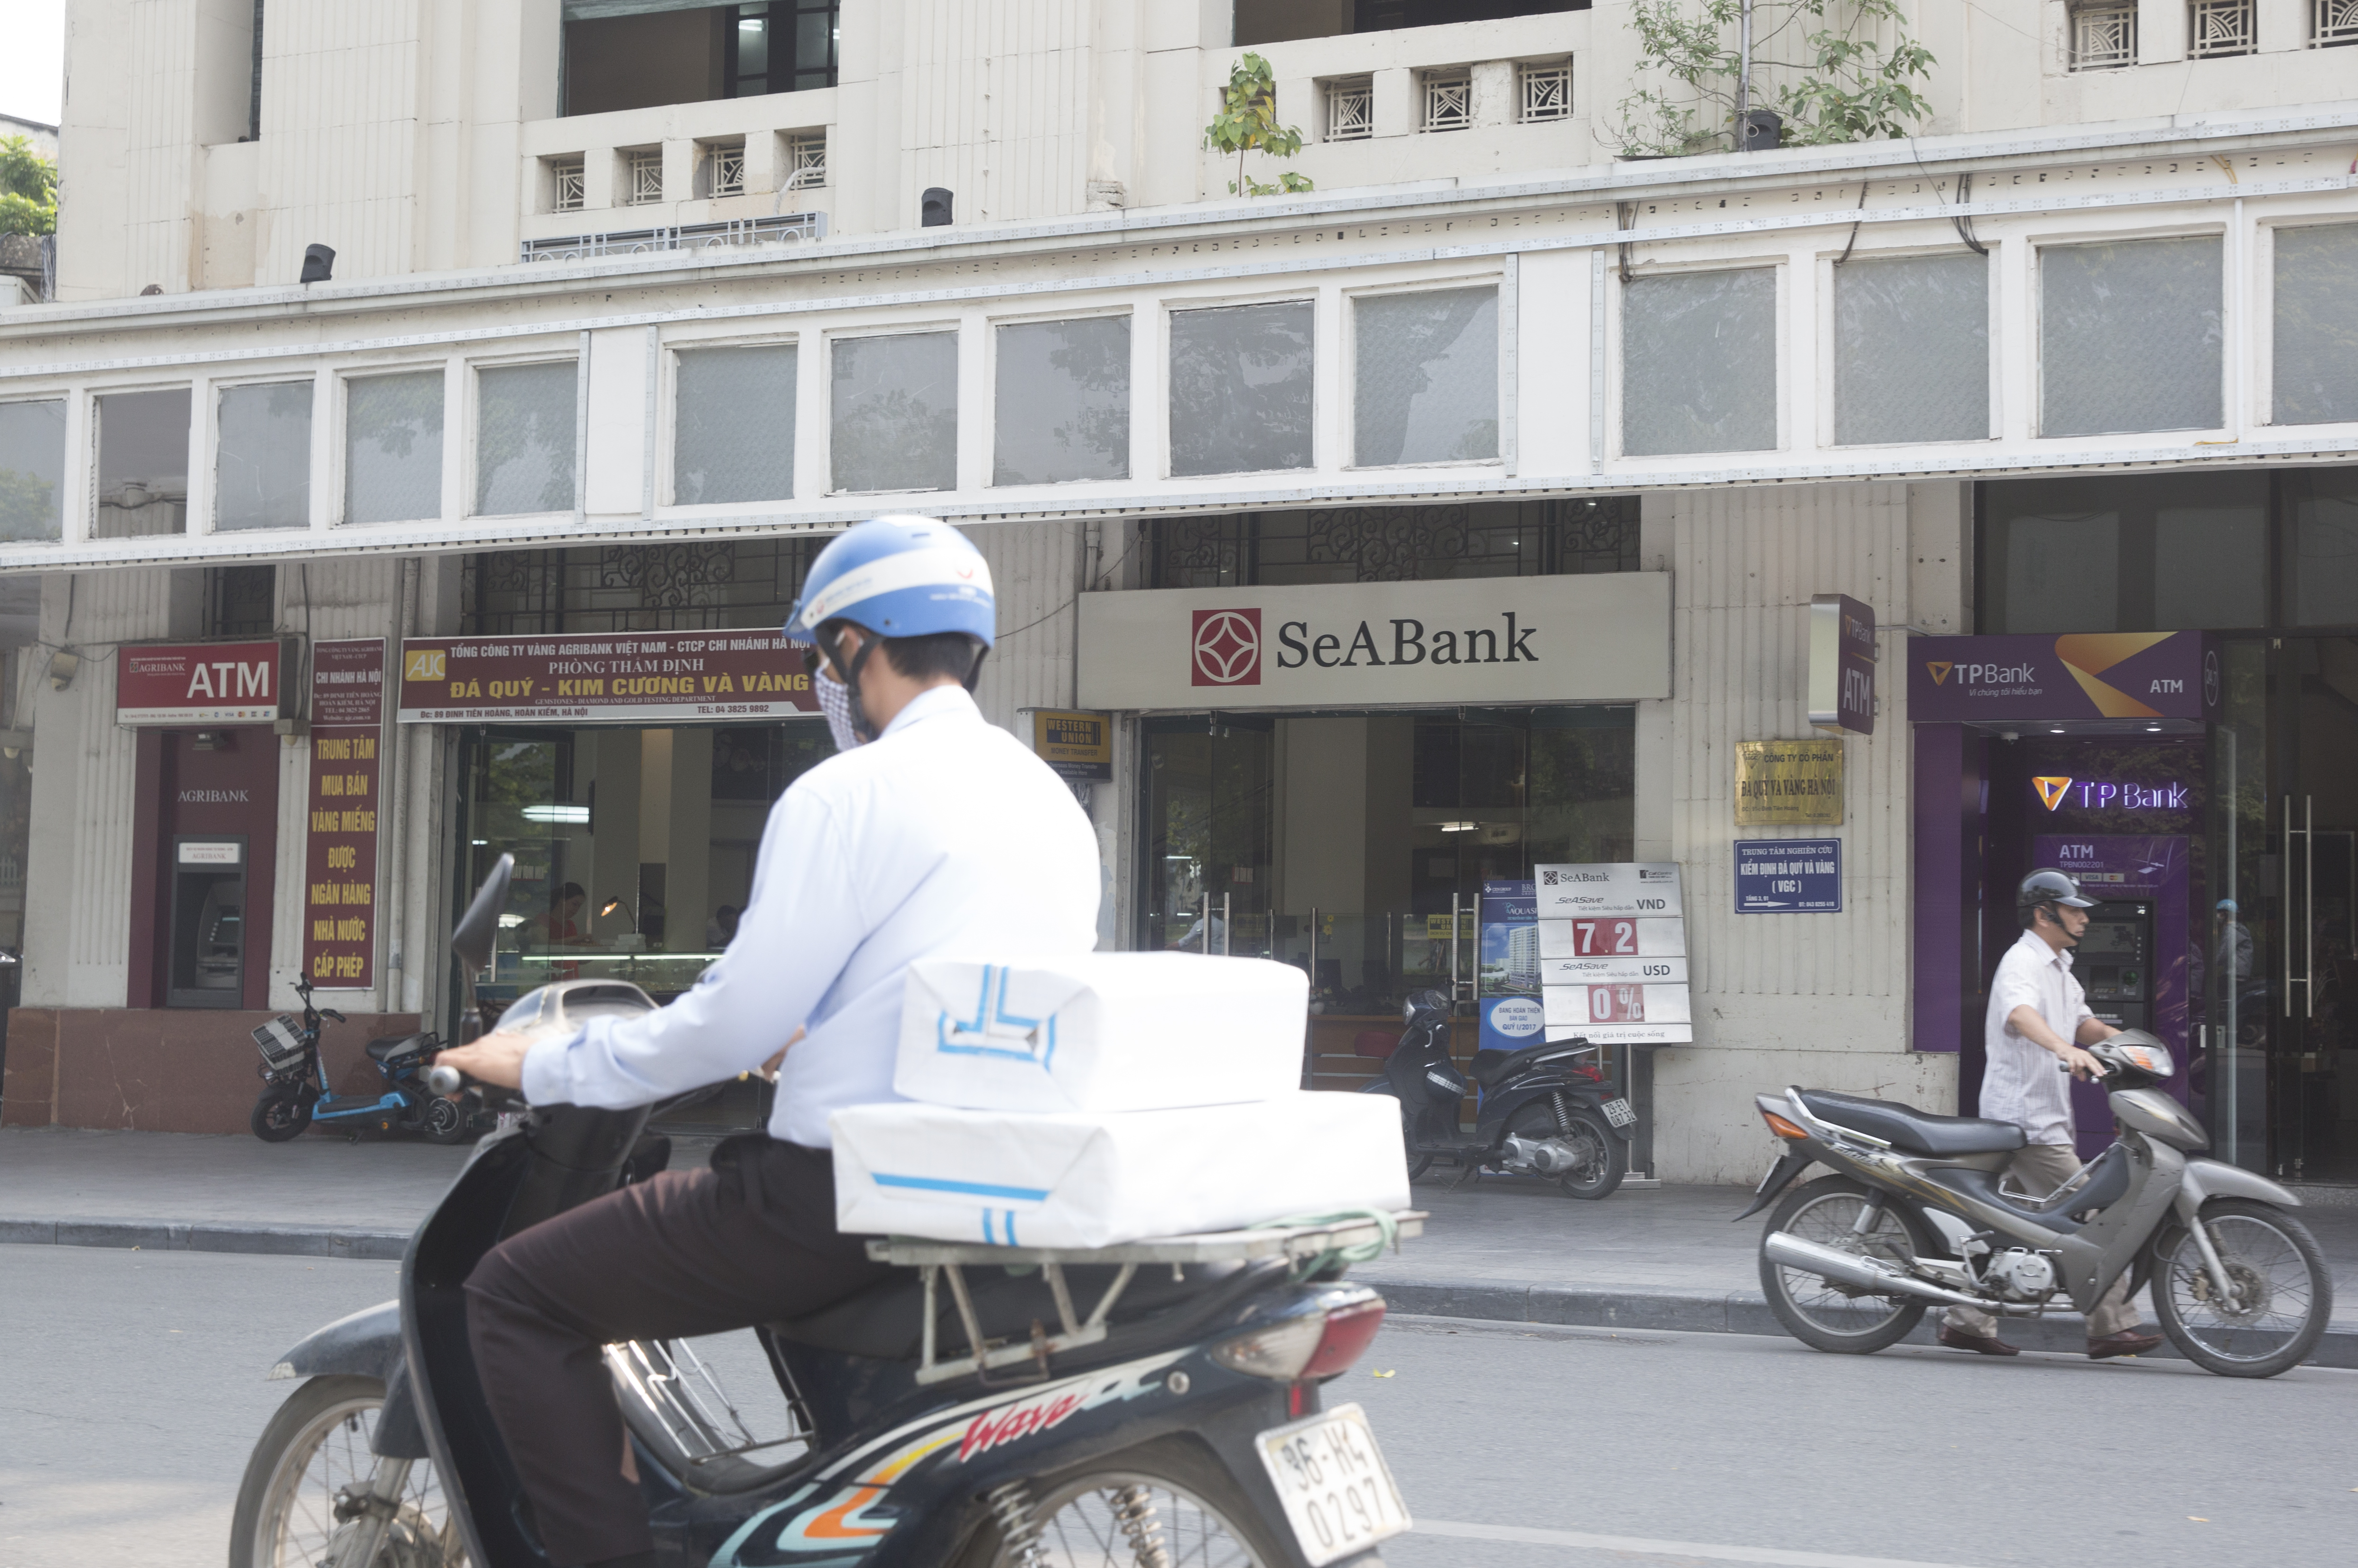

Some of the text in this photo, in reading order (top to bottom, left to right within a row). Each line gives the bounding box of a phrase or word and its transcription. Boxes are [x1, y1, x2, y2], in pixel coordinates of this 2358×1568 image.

[451, 643, 478, 658] TỔNG
[481, 644, 509, 657] CÔNG
[512, 645, 524, 656] TY
[528, 642, 555, 656] VÀNG
[558, 643, 613, 655] AGRIBANK
[616, 640, 639, 656] VIỆT
[641, 641, 667, 654] NAM
[678, 641, 705, 652] CTCP
[709, 640, 726, 651] CHI
[730, 637, 769, 650] NHÁNH
[772, 636, 787, 649] HÀ
[1277, 612, 1539, 668] SeABank
[139, 663, 185, 672] AGRIBANK
[549, 658, 605, 674] PHÒNG
[663, 658, 705, 675] ĐỊNH
[1954, 663, 2035, 684] TPBank
[186, 661, 269, 698] ATM
[316, 672, 328, 684] CHI
[450, 671, 809, 699] ĐÁ QUÝ KIM CƯƠNG VÀ VÀNG
[2150, 679, 2182, 693] ATM
[1843, 668, 1870, 716] ATM
[515, 707, 536, 717] HOÀN
[562, 707, 573, 716] HÀ
[575, 707, 588, 717] NỘI
[1048, 719, 1091, 733] WESTERN
[317, 734, 375, 760] TRUNG TÂM
[1061, 732, 1091, 744] UNION
[1764, 753, 1785, 762] CÔNG
[1787, 754, 1797, 762] TY
[321, 770, 368, 796] MUA BÁN
[1783, 774, 1806, 796] VÀNG
[1808, 774, 1819, 796] HÀ
[177, 789, 249, 802] AGRIBANK
[312, 805, 375, 832] VÀNG MIẾNG
[328, 845, 356, 872] ĐƯỢC
[1769, 846, 1785, 855] TÂM
[1787, 846, 1816, 854] NGHIÊN
[2059, 844, 2093, 859] ATM
[1560, 872, 1610, 882] SeABank
[311, 879, 371, 905] NGÂN HÀNG
[1636, 899, 1665, 909] VND
[314, 916, 366, 941] NHÀ NƯỚC
[314, 949, 364, 978] CẤP PHÉP
[1643, 965, 1670, 975] USD
[1502, 1022, 1515, 1030] QUÝ
[958, 1394, 1091, 1463] Wave
[1307, 1476, 1385, 1548] 0297
